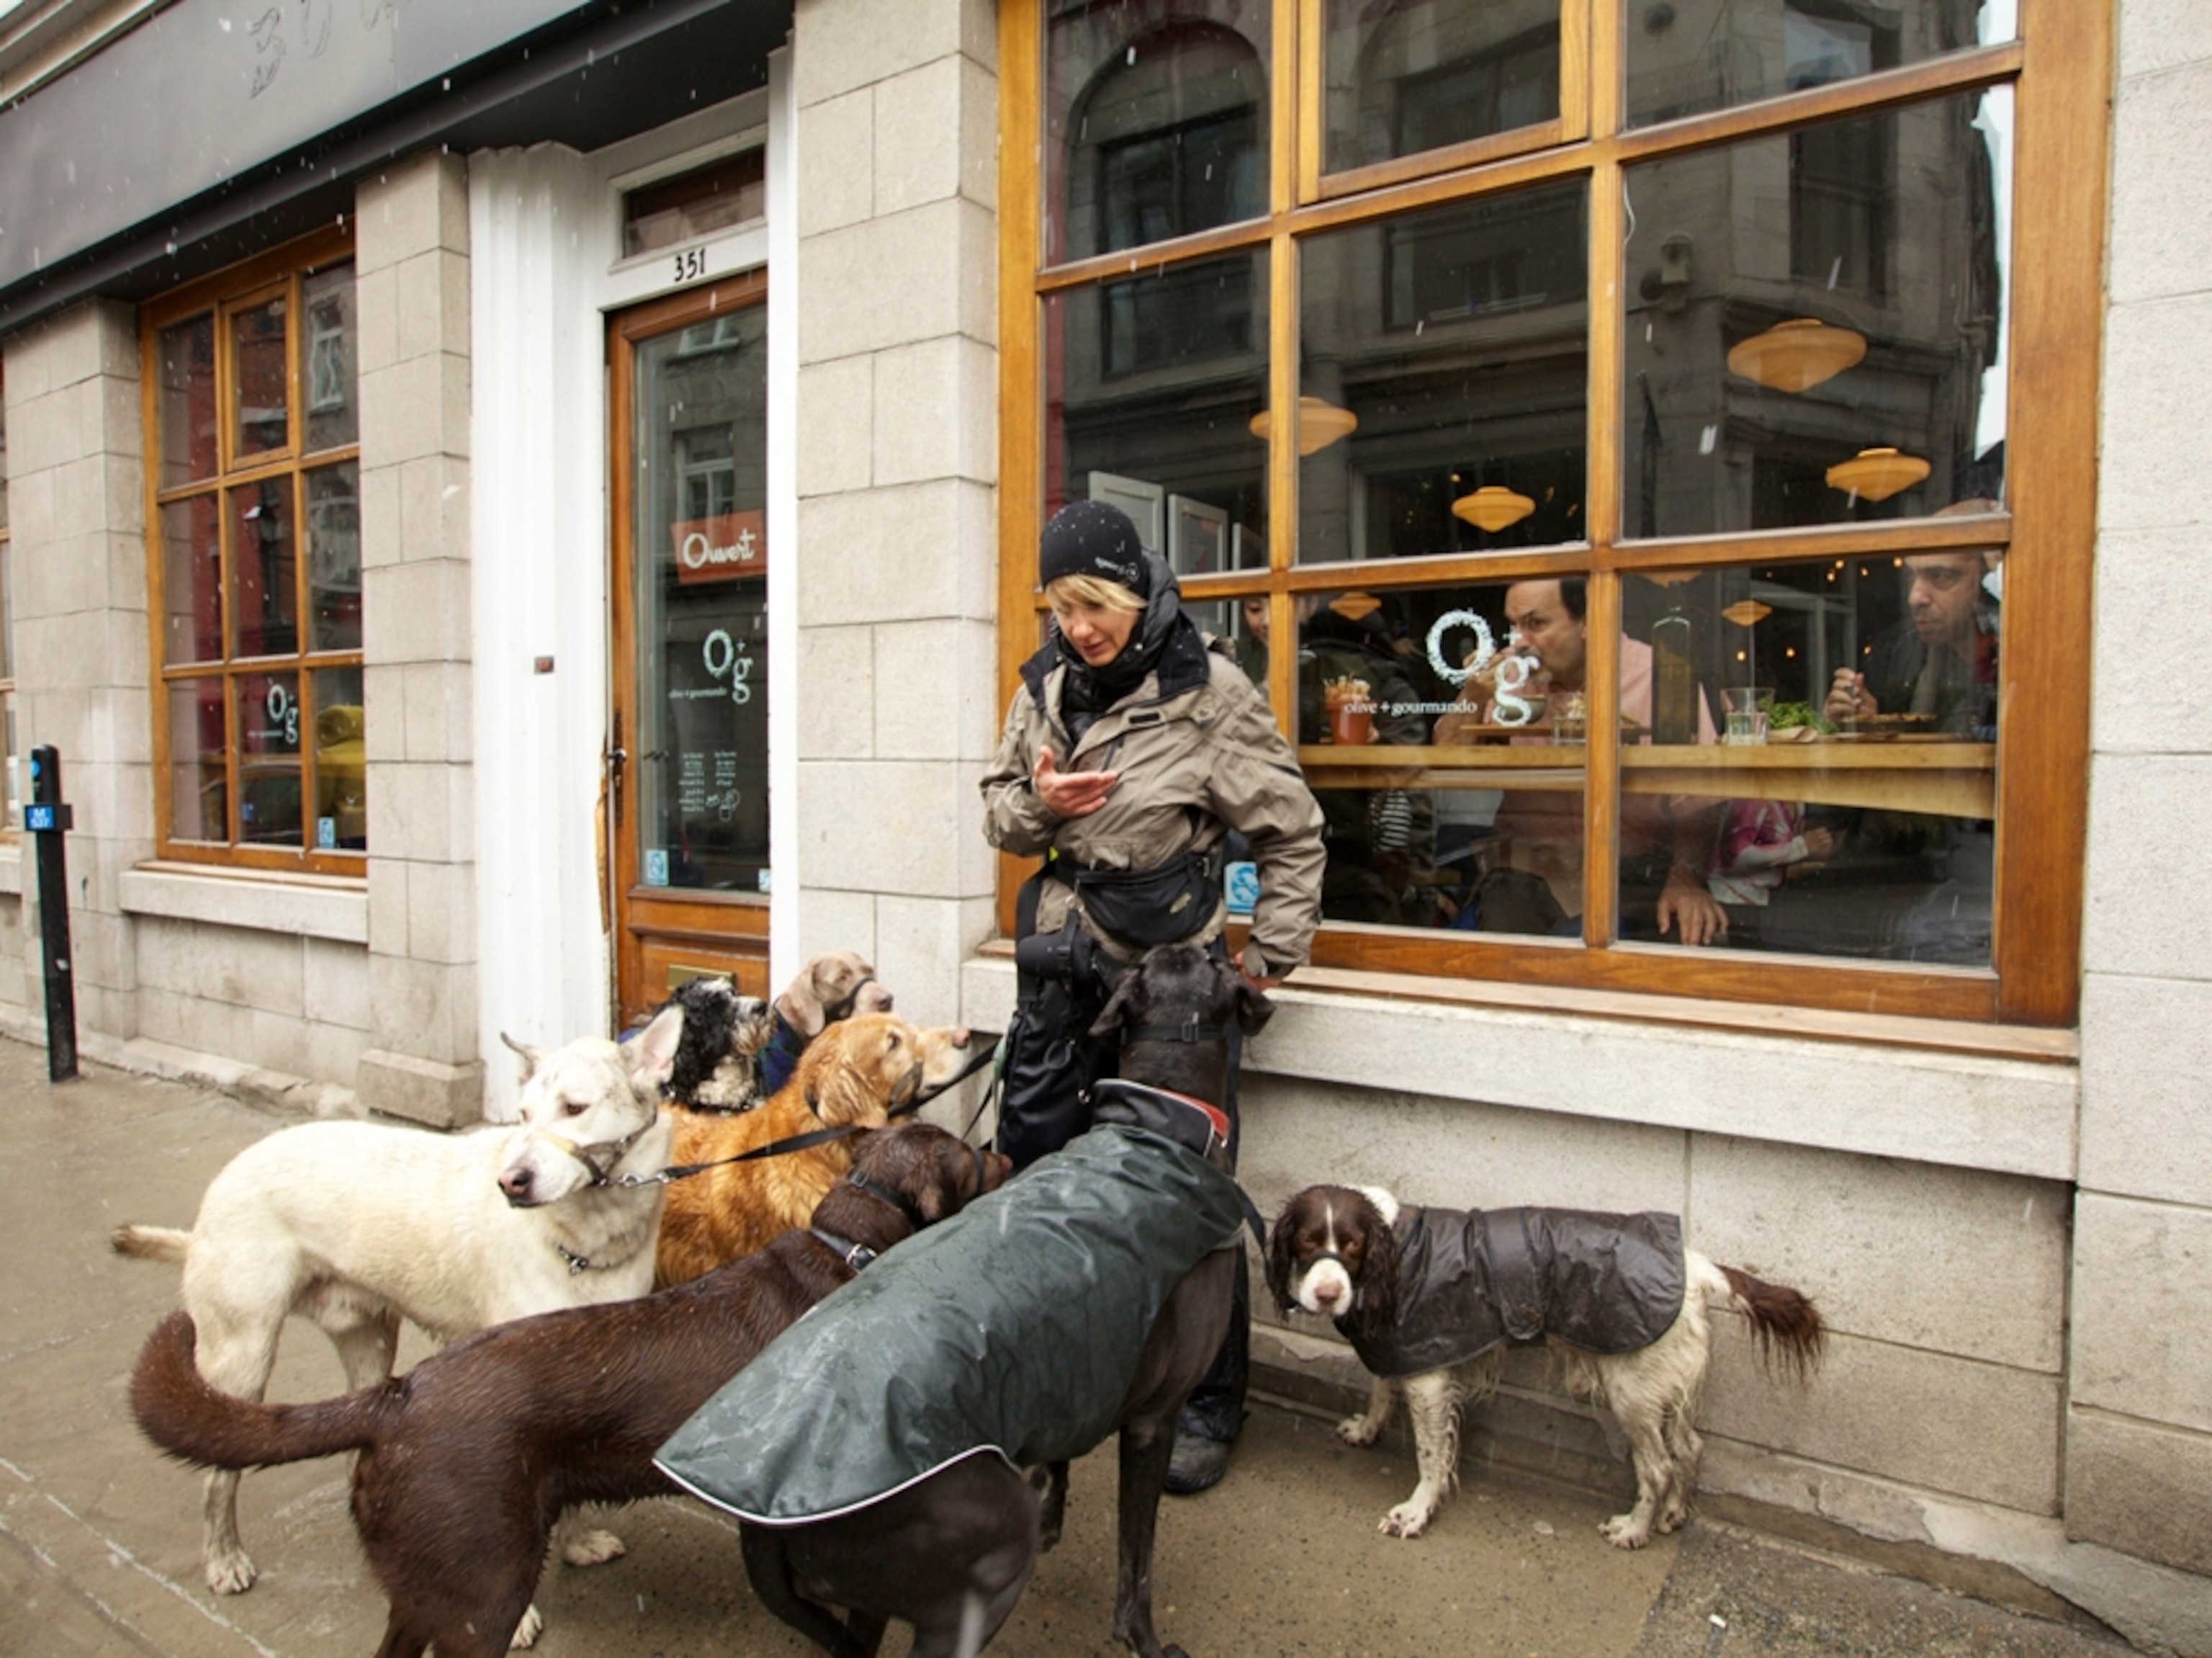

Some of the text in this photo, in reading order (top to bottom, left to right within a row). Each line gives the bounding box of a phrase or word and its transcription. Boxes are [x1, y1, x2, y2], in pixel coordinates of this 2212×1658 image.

[675, 248, 705, 282] 351
[682, 527, 756, 569] Ouvert
[1344, 699, 1377, 714] olive
[1391, 699, 1478, 717] gourmando
